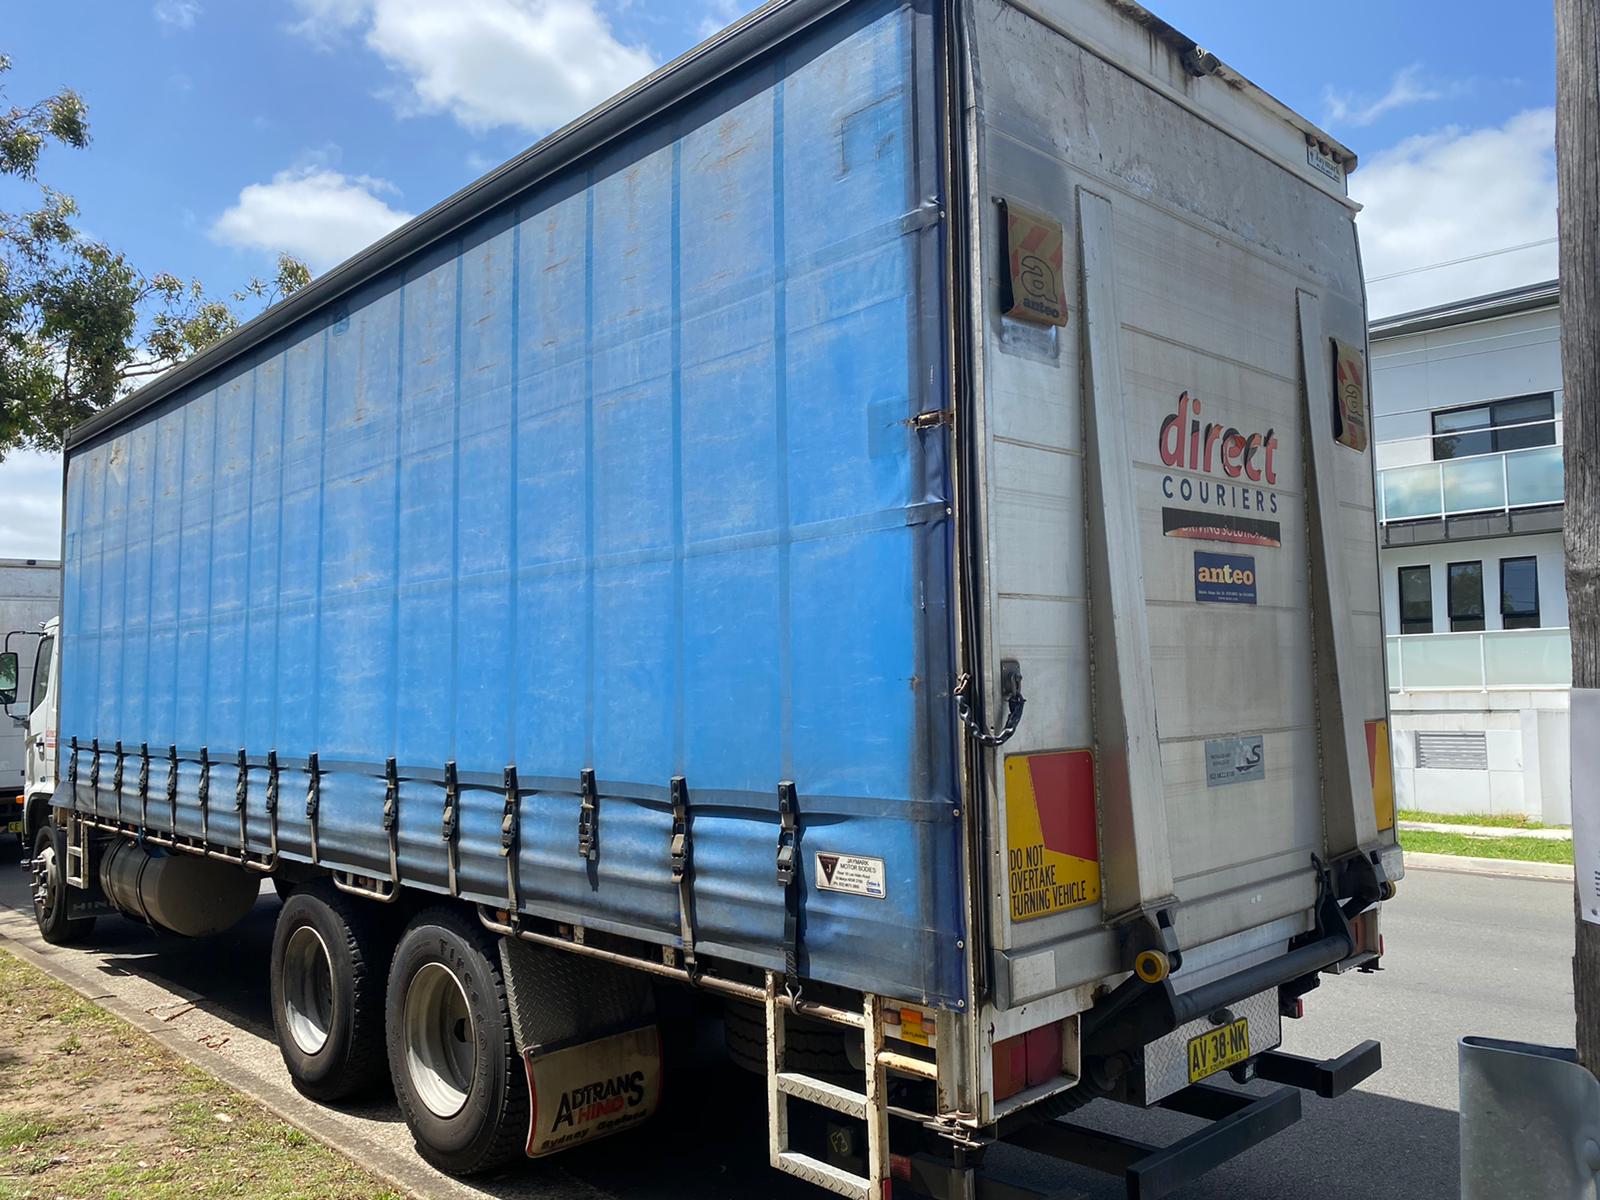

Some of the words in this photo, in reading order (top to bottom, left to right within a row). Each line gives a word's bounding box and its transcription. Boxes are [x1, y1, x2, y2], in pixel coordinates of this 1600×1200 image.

[1159, 390, 1278, 485] direct
[1162, 475, 1277, 514] COURIERS
[1198, 564, 1254, 585] anteo
[840, 863, 857, 871] MOTOR
[857, 865, 877, 873] BODIES
[1010, 847, 1023, 871] DO
[1025, 844, 1044, 869] NOT
[1011, 864, 1057, 894] OVERTAKE
[1012, 887, 1051, 917] TURNING
[1052, 880, 1087, 907] VEHICLE
[551, 1071, 644, 1133] ADTRANS
[576, 1095, 625, 1124] HINO
